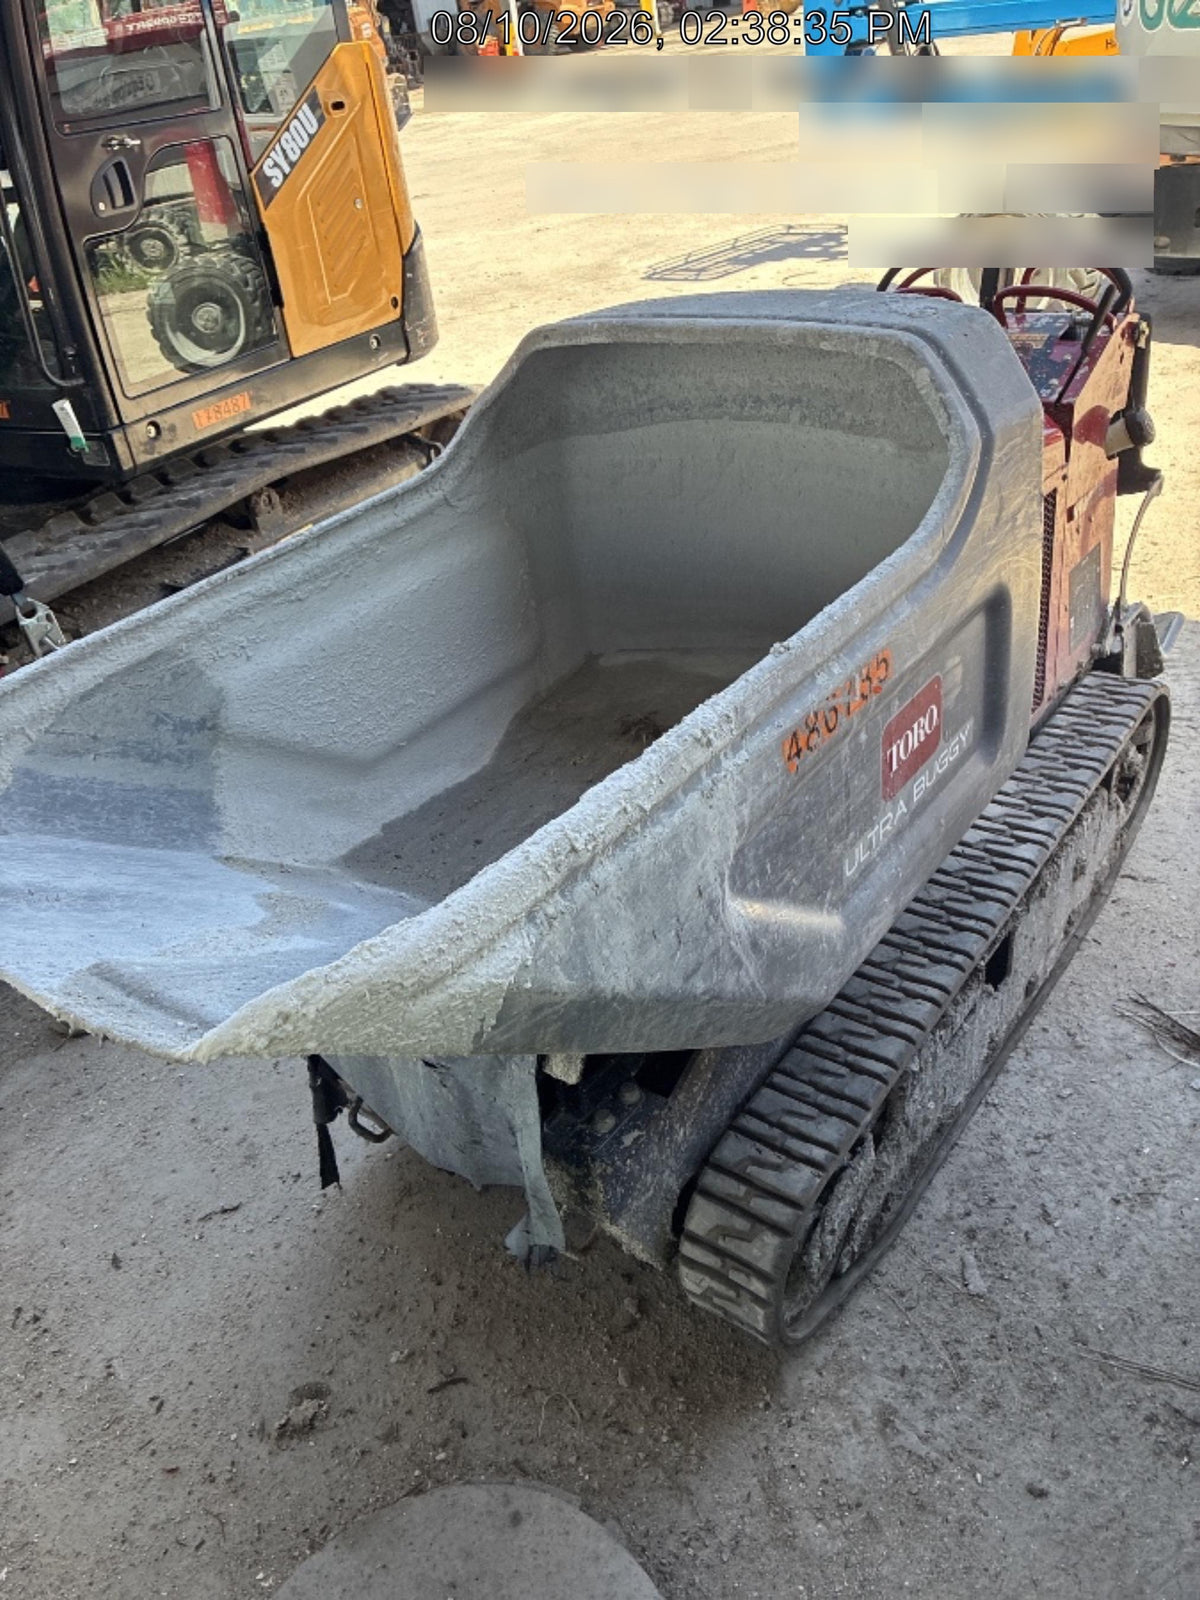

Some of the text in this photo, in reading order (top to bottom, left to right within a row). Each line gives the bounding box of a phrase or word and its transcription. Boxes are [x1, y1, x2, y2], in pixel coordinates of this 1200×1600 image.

[263, 102, 319, 188] SY80U
[886, 704, 939, 775] TORO
[844, 718, 974, 877] ULTRA BUGGY
